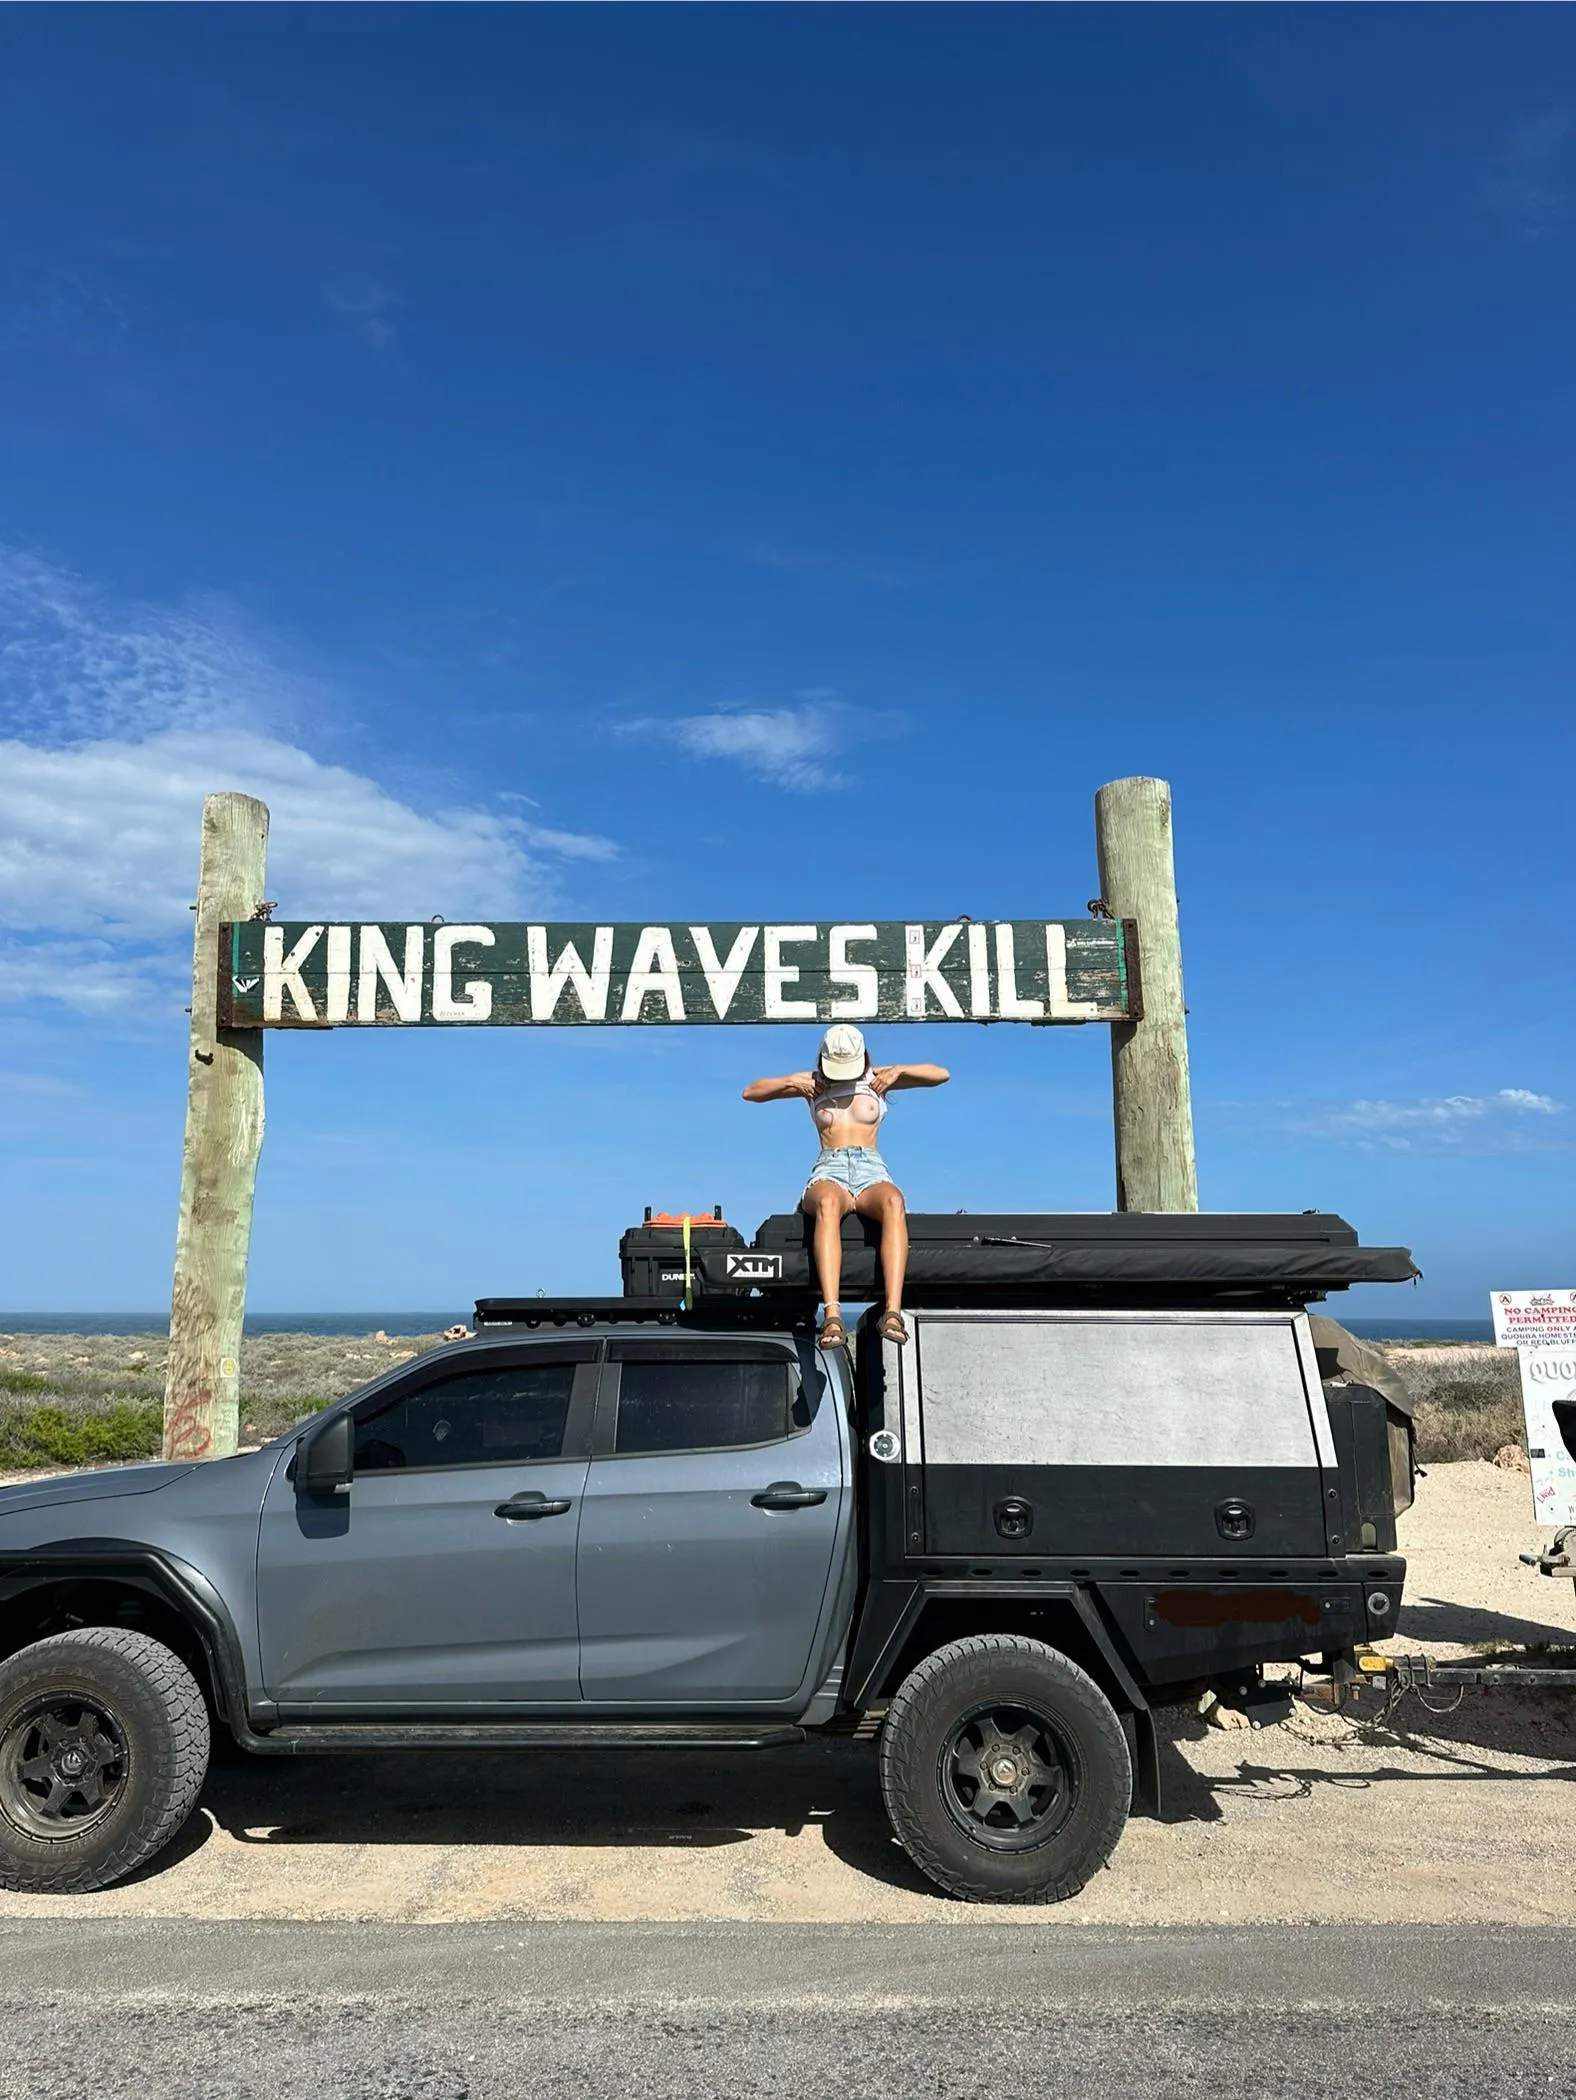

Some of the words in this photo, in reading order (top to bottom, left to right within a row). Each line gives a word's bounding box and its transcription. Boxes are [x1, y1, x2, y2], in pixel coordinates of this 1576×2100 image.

[264, 924, 496, 1022] KING
[526, 923, 879, 1021] WAVES
[903, 923, 1101, 1020] KILL
[727, 1256, 780, 1279] XTM
[1503, 1307, 1521, 1315] NO
[1508, 1315, 1576, 1324] PERMITTED
